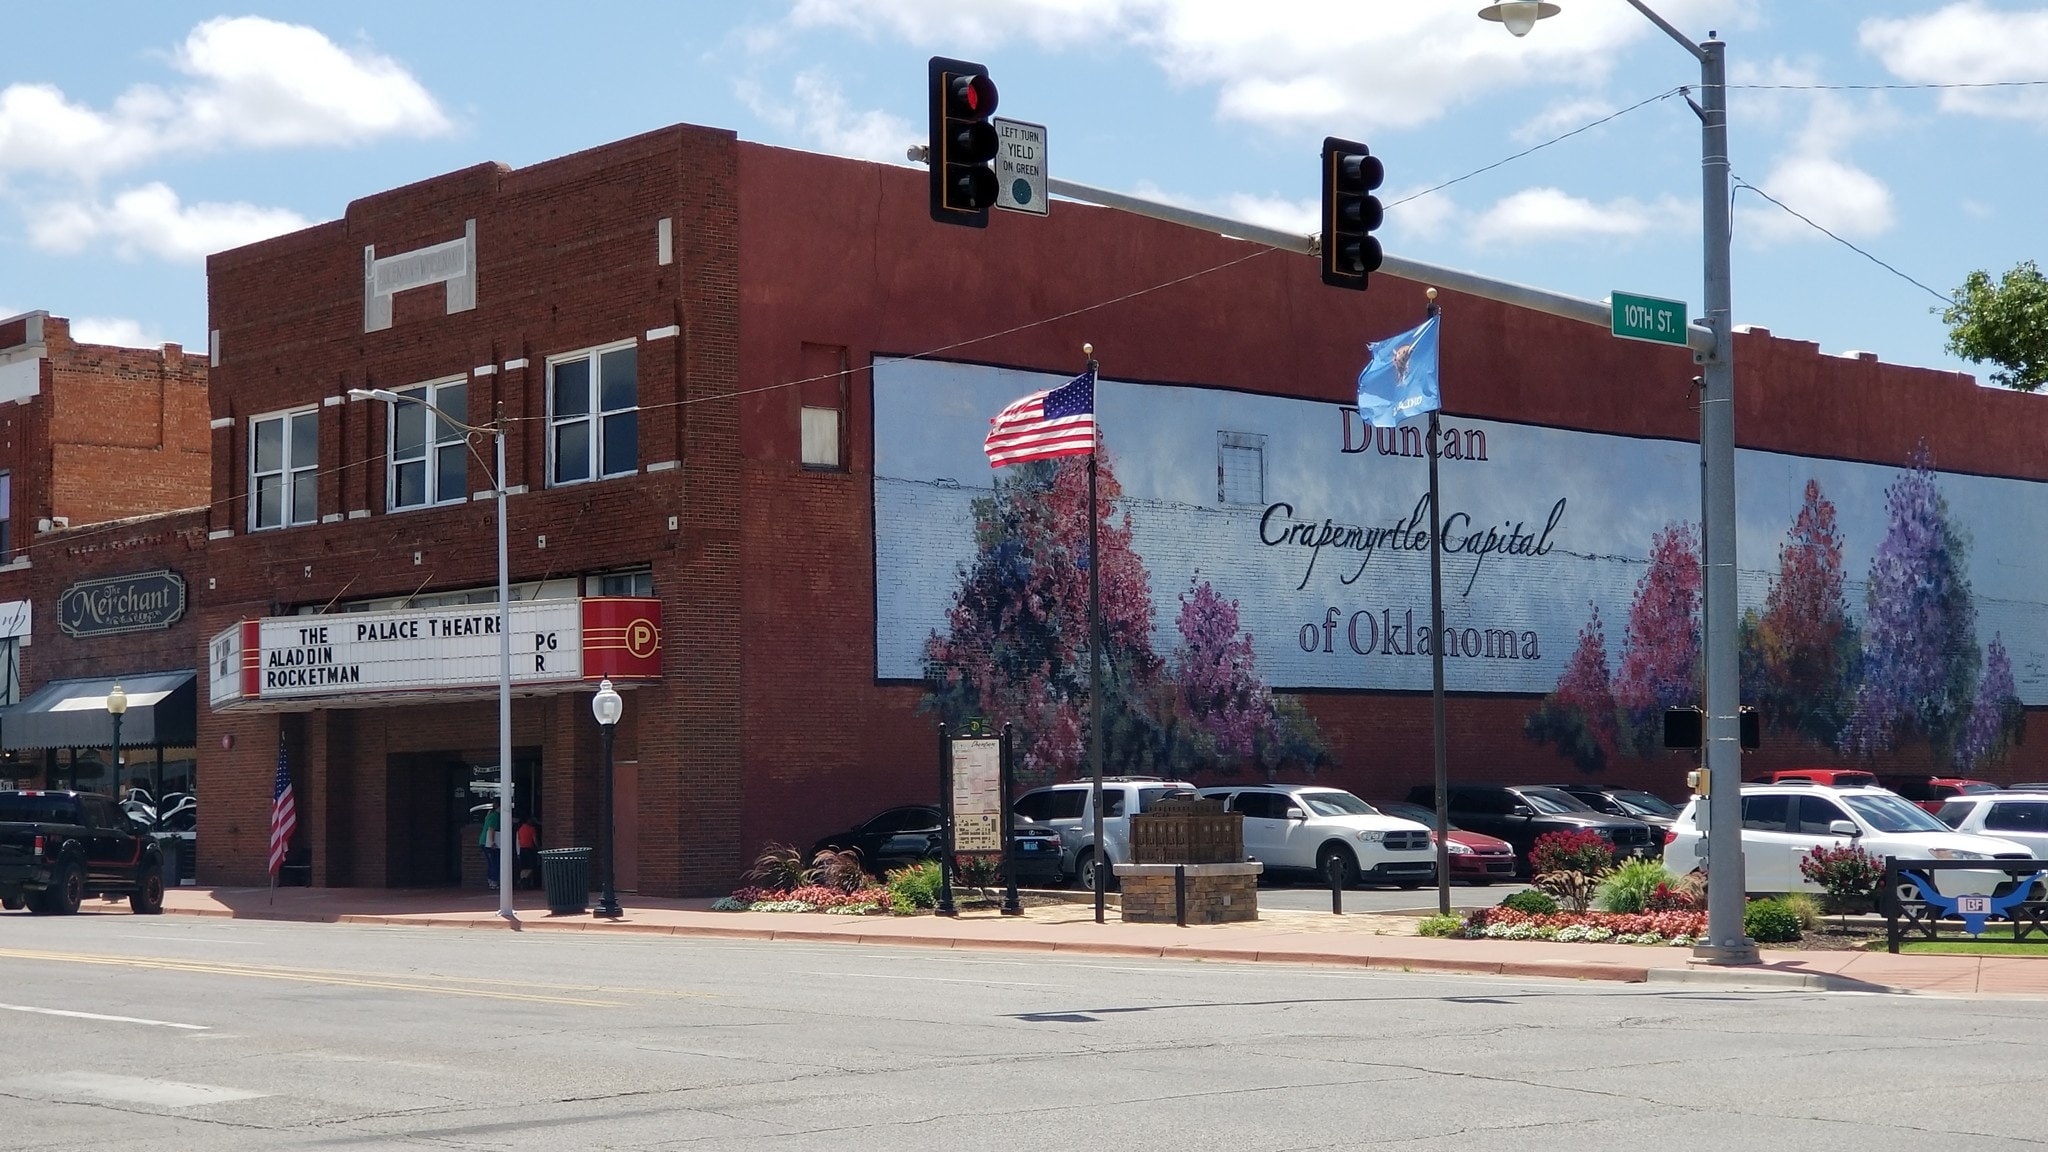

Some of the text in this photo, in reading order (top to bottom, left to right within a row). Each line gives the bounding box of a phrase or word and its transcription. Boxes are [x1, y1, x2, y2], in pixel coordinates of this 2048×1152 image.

[1001, 126, 1040, 143] LEFT TURN
[1008, 143, 1034, 160] YIELD
[1003, 160, 1039, 177] ON GREEN
[1624, 304, 1675, 334] 10TH ST.
[1259, 492, 1567, 597] Crapemyrtle Capital
[104, 584, 121, 599] The
[72, 584, 171, 627] Merchant
[299, 627, 328, 645] THE
[357, 620, 418, 641] PALACE
[634, 626, 651, 650] P
[1299, 606, 1542, 660] of Oklahoma
[268, 632, 558, 667] ALADDIN PG
[267, 654, 546, 688] ROCKETMAN R
[1967, 899, 1984, 911] BF
